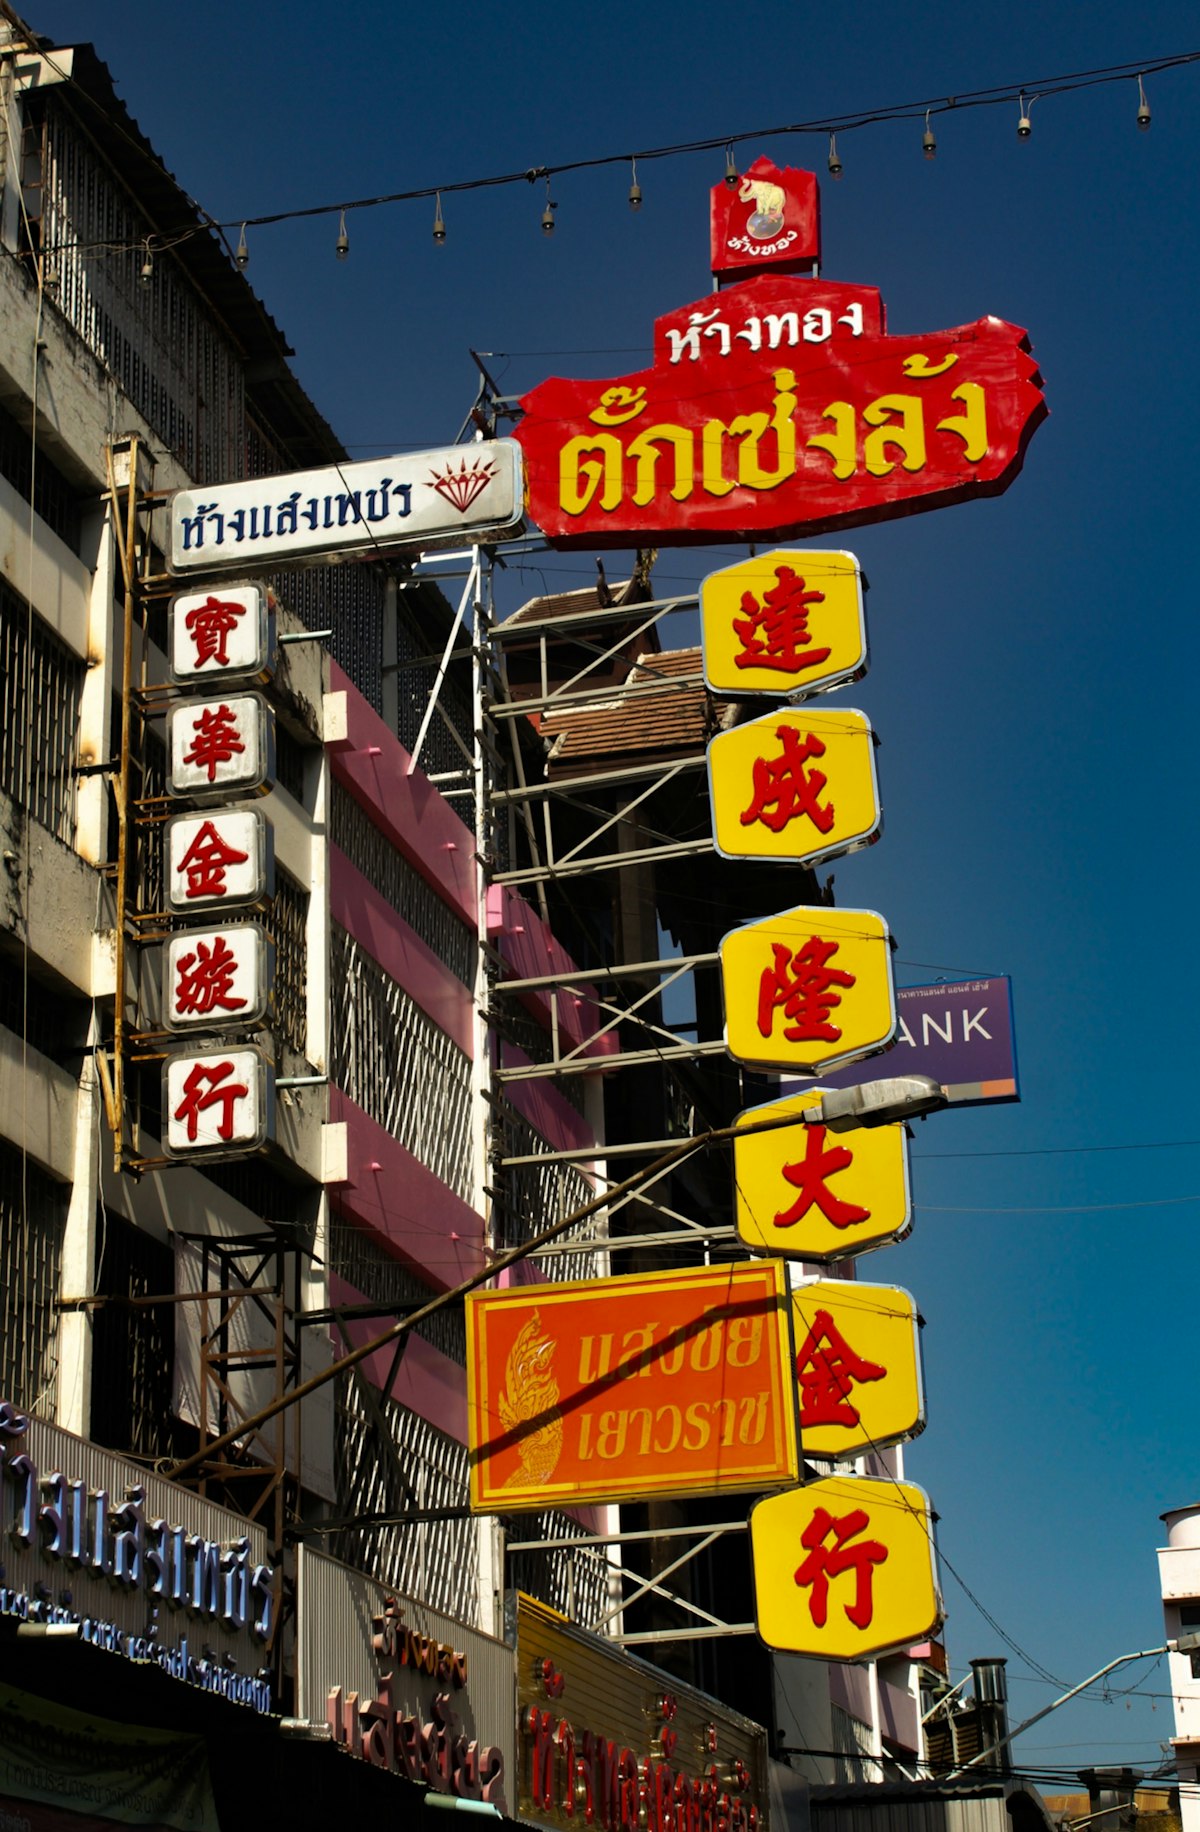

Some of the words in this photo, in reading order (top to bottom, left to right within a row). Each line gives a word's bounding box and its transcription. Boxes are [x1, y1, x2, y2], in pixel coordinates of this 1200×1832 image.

[727, 230, 799, 256] ห้างทอง
[665, 302, 864, 365] ห้างทอง
[578, 1392, 771, 1461] เยาวราช
